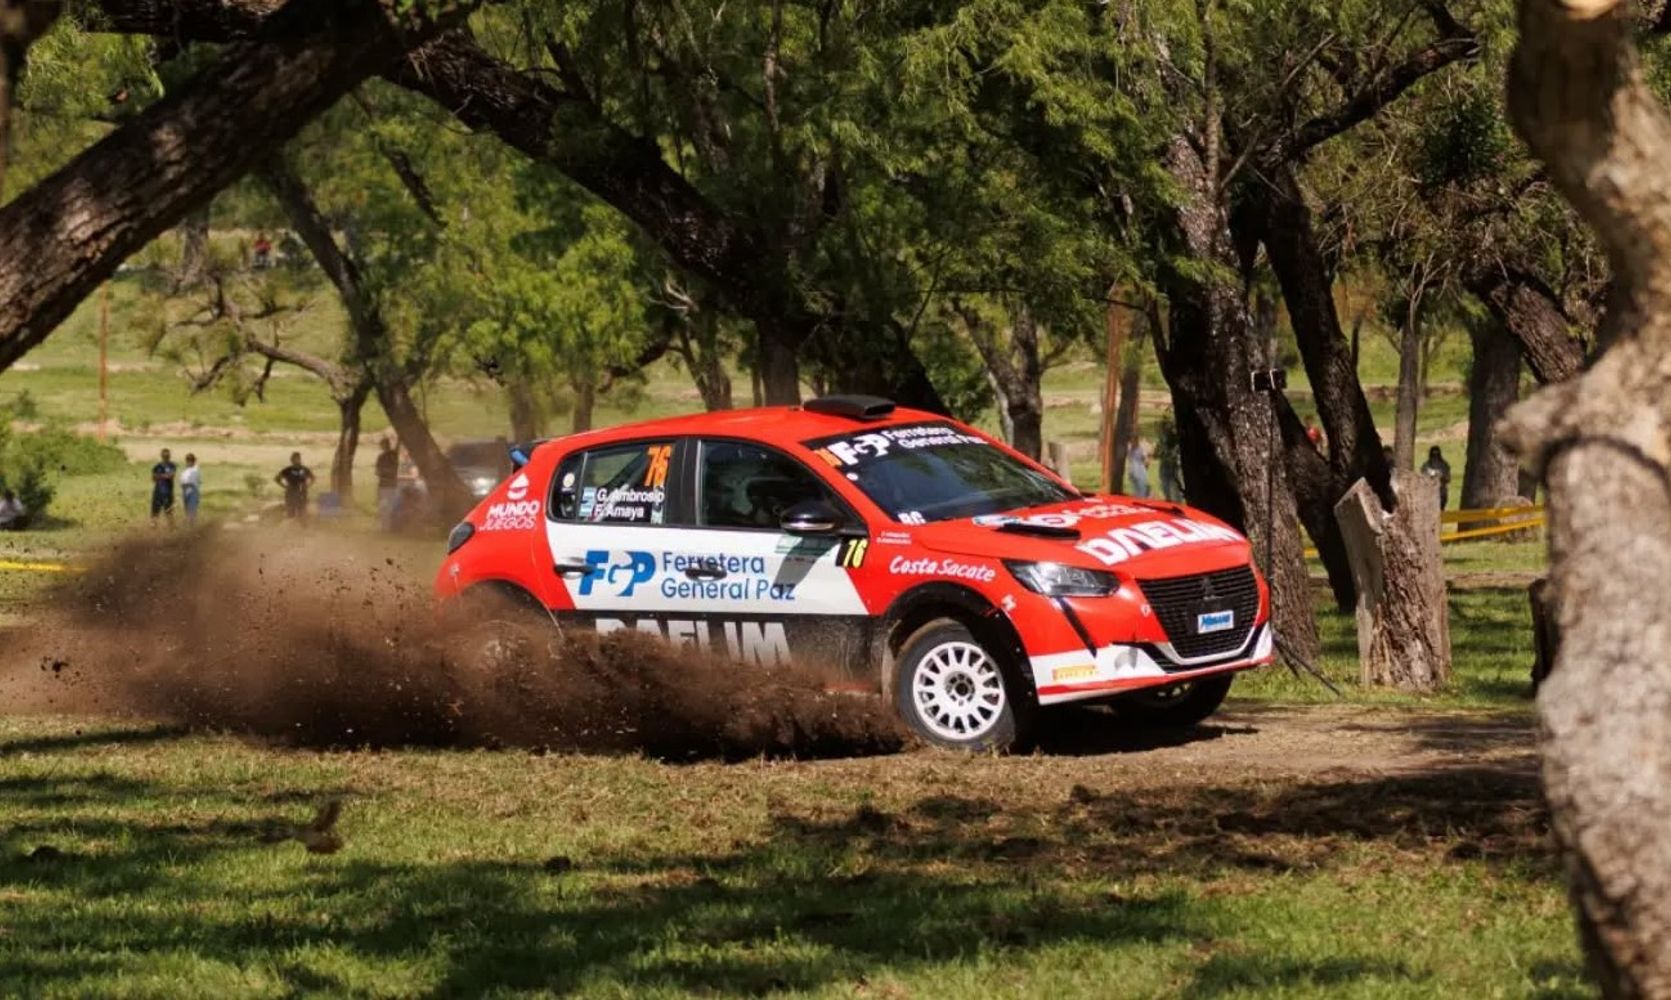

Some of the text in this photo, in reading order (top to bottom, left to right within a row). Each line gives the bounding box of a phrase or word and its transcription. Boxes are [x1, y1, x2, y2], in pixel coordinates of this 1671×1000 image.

[644, 445, 672, 488] 76
[486, 500, 540, 520] MUNDO
[479, 515, 536, 531] JUEGOS
[662, 552, 765, 574] Ferretera
[889, 555, 996, 582] Costa Sacate
[660, 577, 796, 600] General Paz
